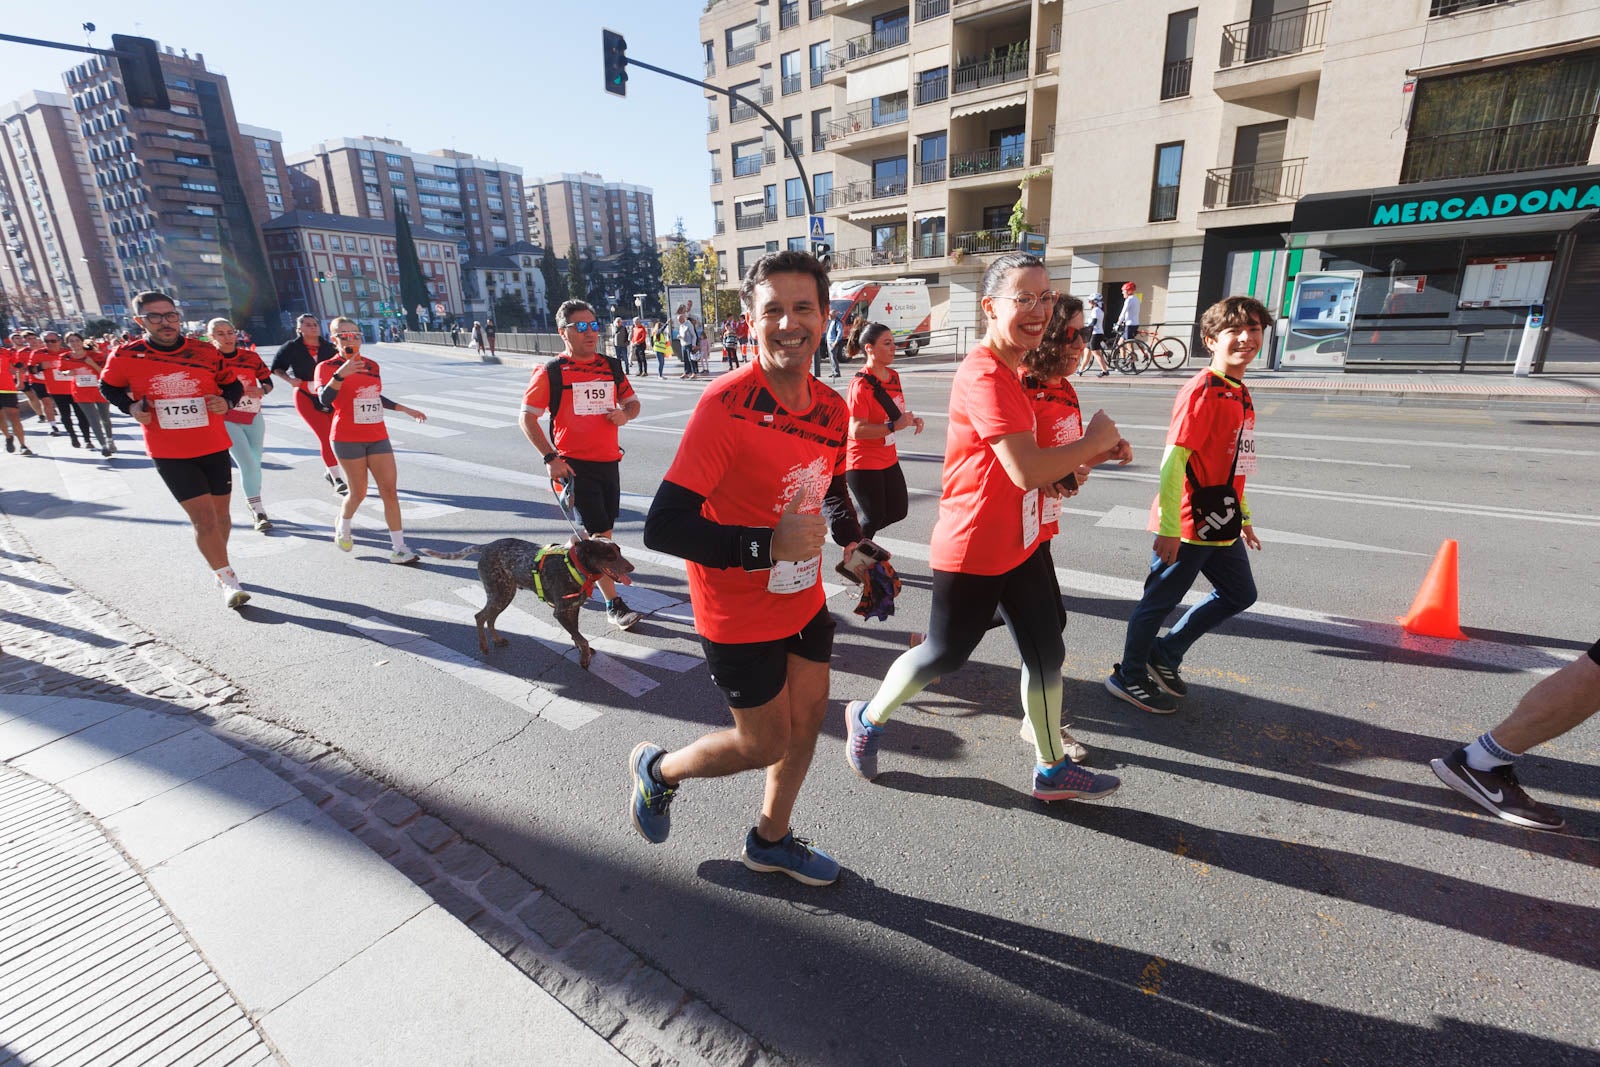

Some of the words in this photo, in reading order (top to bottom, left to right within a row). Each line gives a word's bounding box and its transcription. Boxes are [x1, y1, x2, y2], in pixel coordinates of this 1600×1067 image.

[1373, 185, 1600, 225] MERCADONA
[584, 389, 605, 399] 159
[164, 404, 198, 416] 1756
[360, 403, 380, 412] 1757
